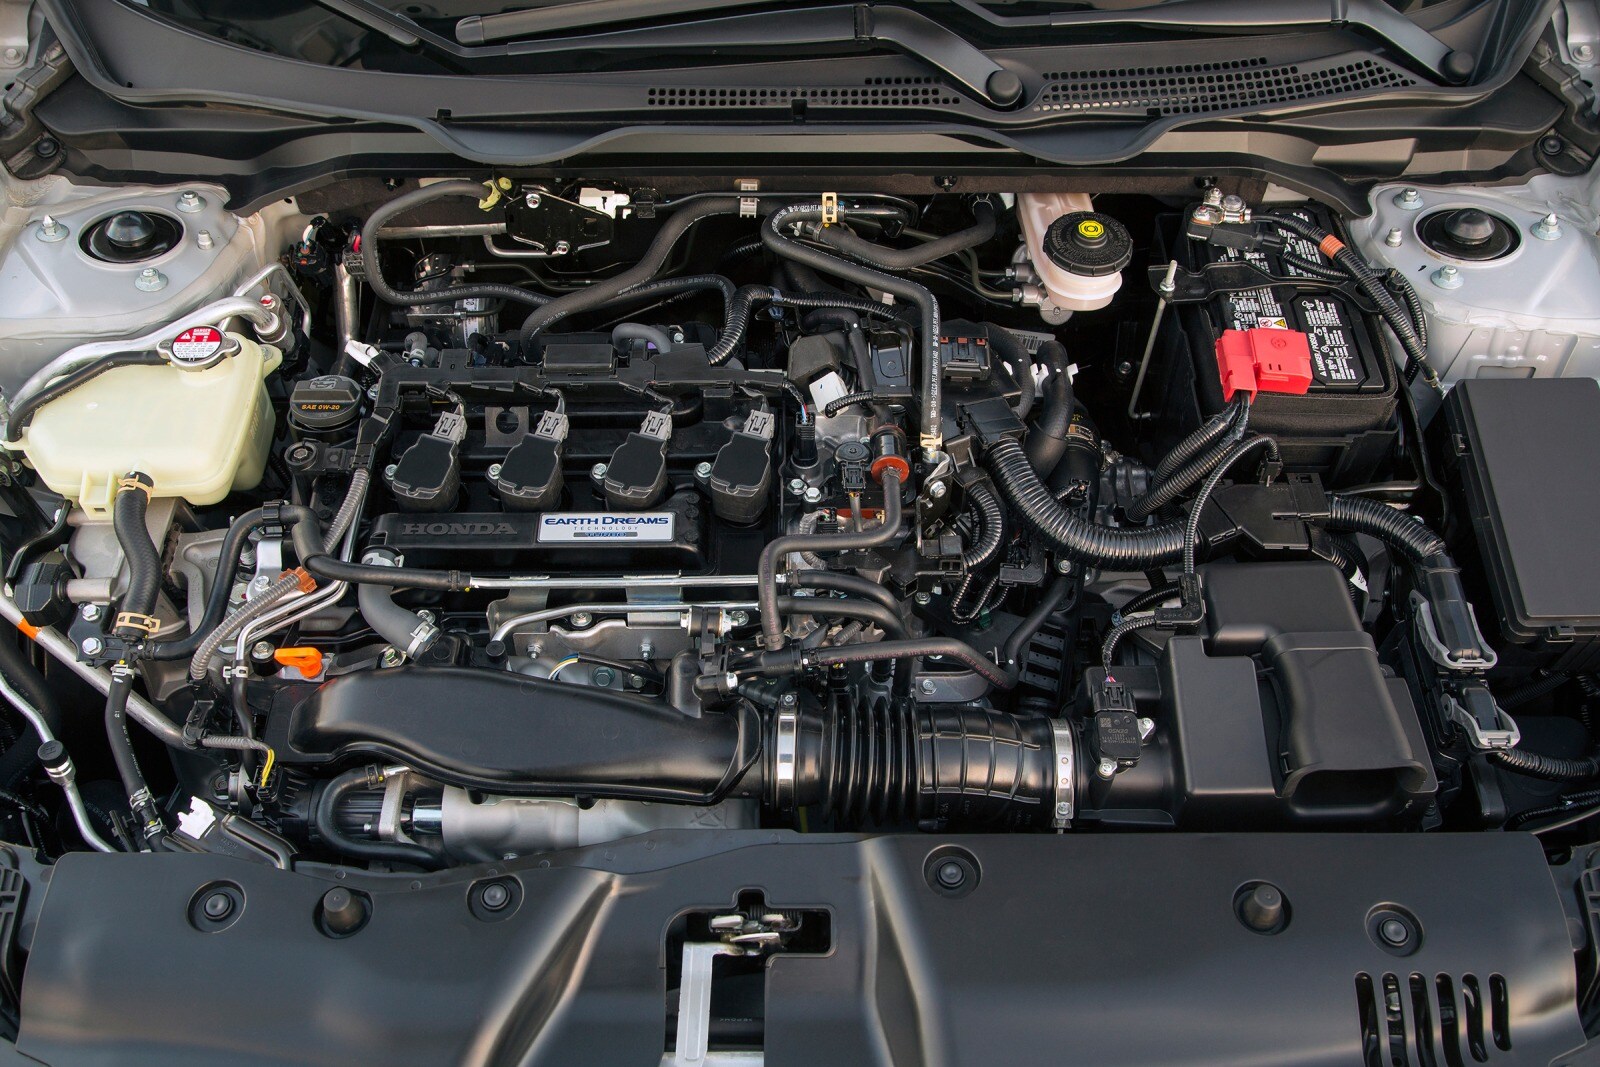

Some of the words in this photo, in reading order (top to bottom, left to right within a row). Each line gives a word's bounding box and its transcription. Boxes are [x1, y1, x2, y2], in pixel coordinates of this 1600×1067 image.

[544, 517, 599, 525] EARTH
[601, 516, 669, 525] DREAMS
[401, 522, 518, 535] HONDA
